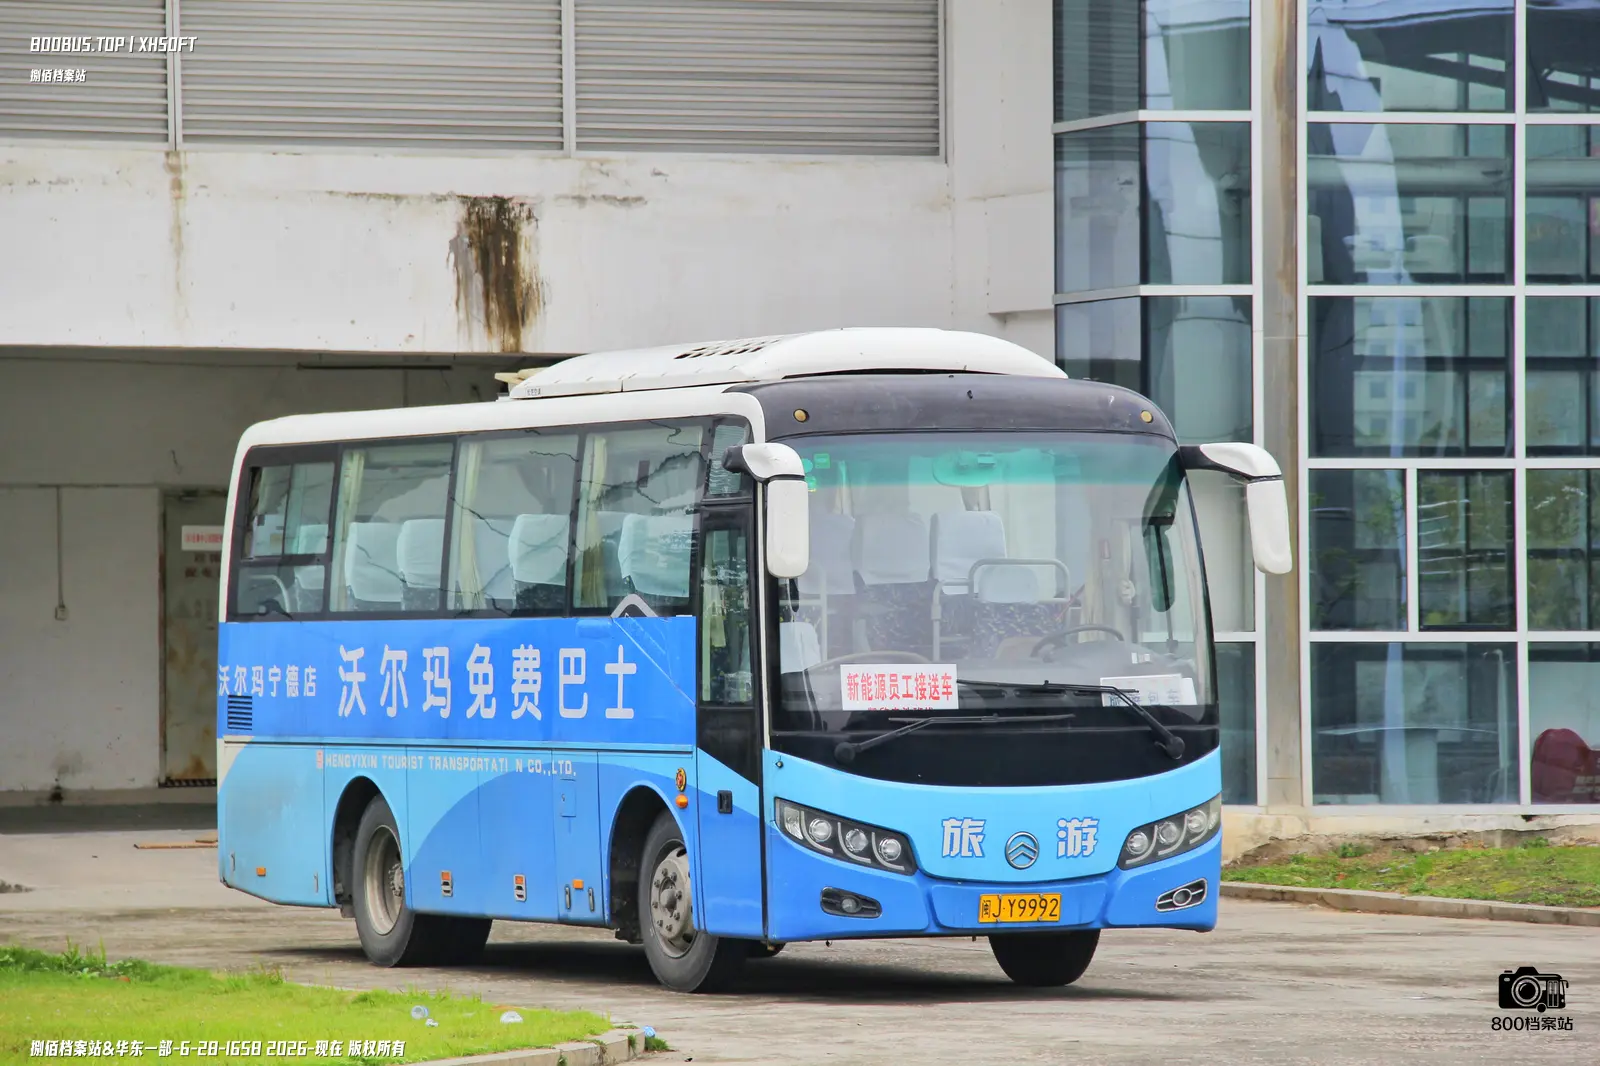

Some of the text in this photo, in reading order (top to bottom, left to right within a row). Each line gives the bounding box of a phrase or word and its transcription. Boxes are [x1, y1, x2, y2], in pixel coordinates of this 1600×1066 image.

[218, 664, 317, 698] 沃尔玛宁德店
[338, 643, 637, 721] 沃尔玛免费巴士
[846, 672, 953, 701] 新能源员工接送车
[382, 754, 424, 770] TOURIST
